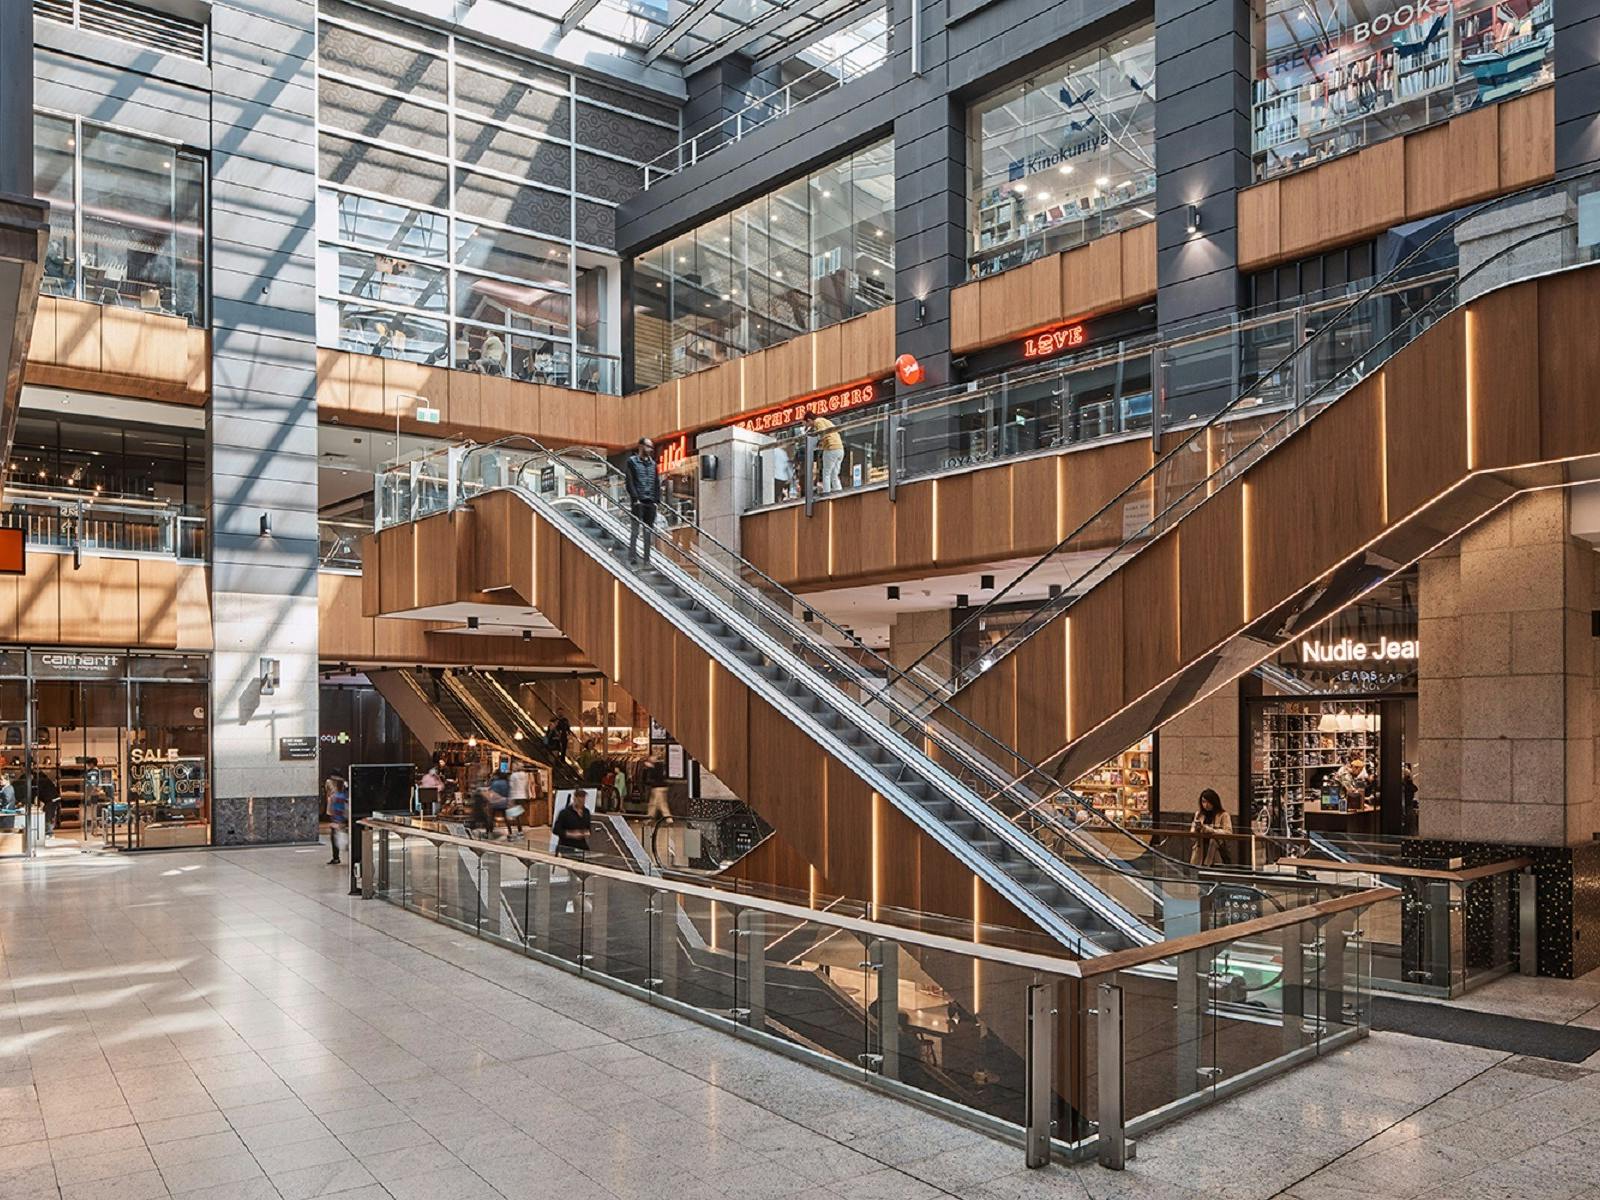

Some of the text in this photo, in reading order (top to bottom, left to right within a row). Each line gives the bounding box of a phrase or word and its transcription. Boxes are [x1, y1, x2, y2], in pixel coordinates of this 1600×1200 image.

[1028, 132, 1109, 173] Kinokuniya
[736, 385, 873, 432] EALTHY BURGERS
[656, 435, 686, 473] ill'd
[42, 654, 118, 666] carhartt
[1302, 636, 1419, 663] Nudie Jea
[131, 748, 179, 763] SALE
